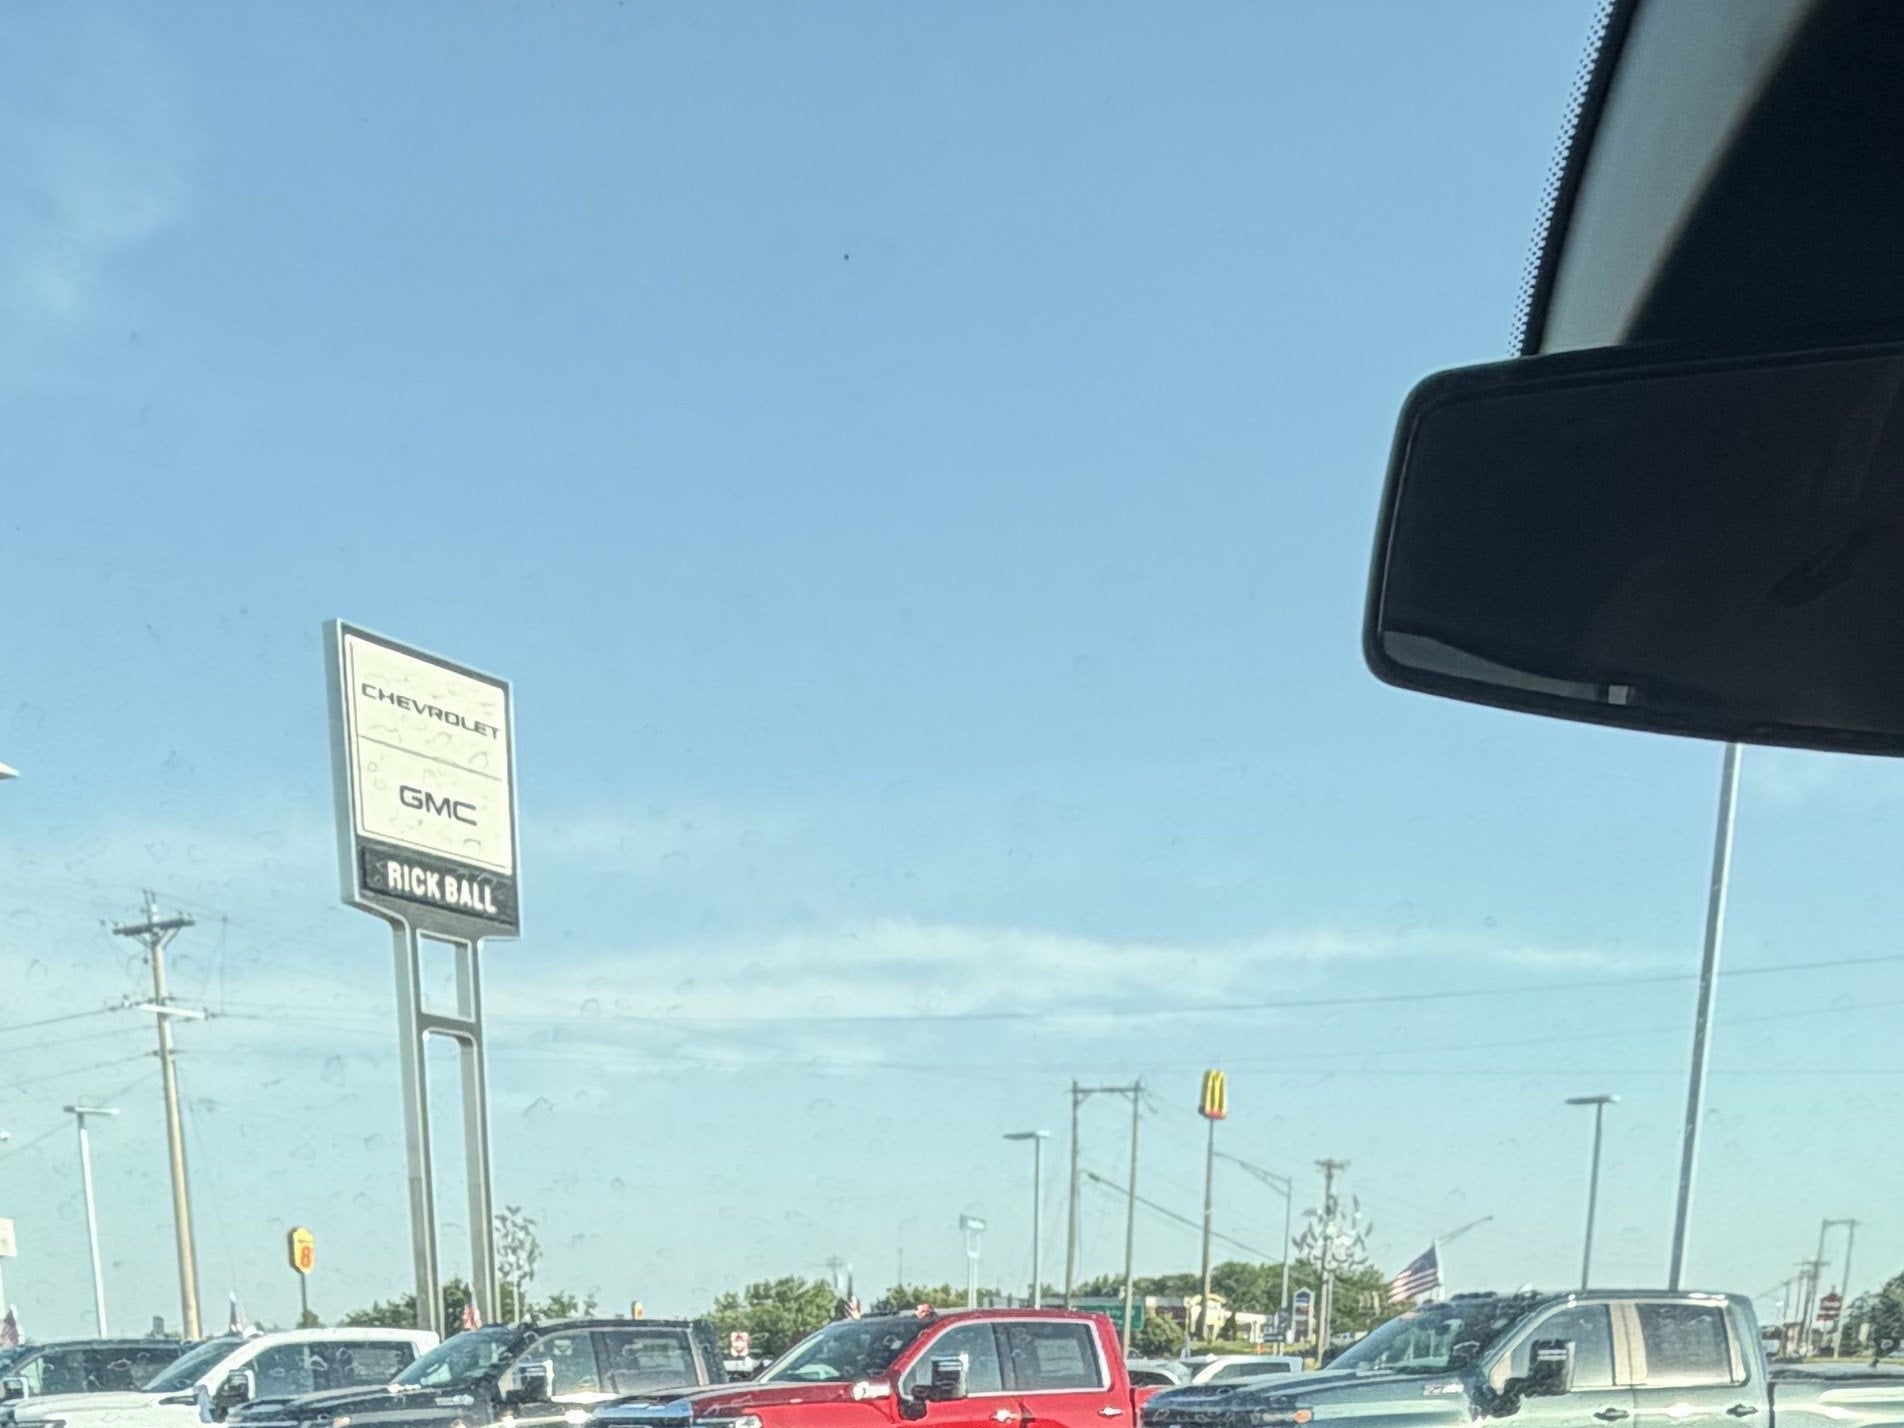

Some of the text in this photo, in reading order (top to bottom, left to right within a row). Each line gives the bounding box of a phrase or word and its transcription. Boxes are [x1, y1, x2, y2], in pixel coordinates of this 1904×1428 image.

[362, 683, 500, 739] CHEVROLET
[399, 785, 477, 826] GMC
[388, 861, 497, 913] RICK BALL
